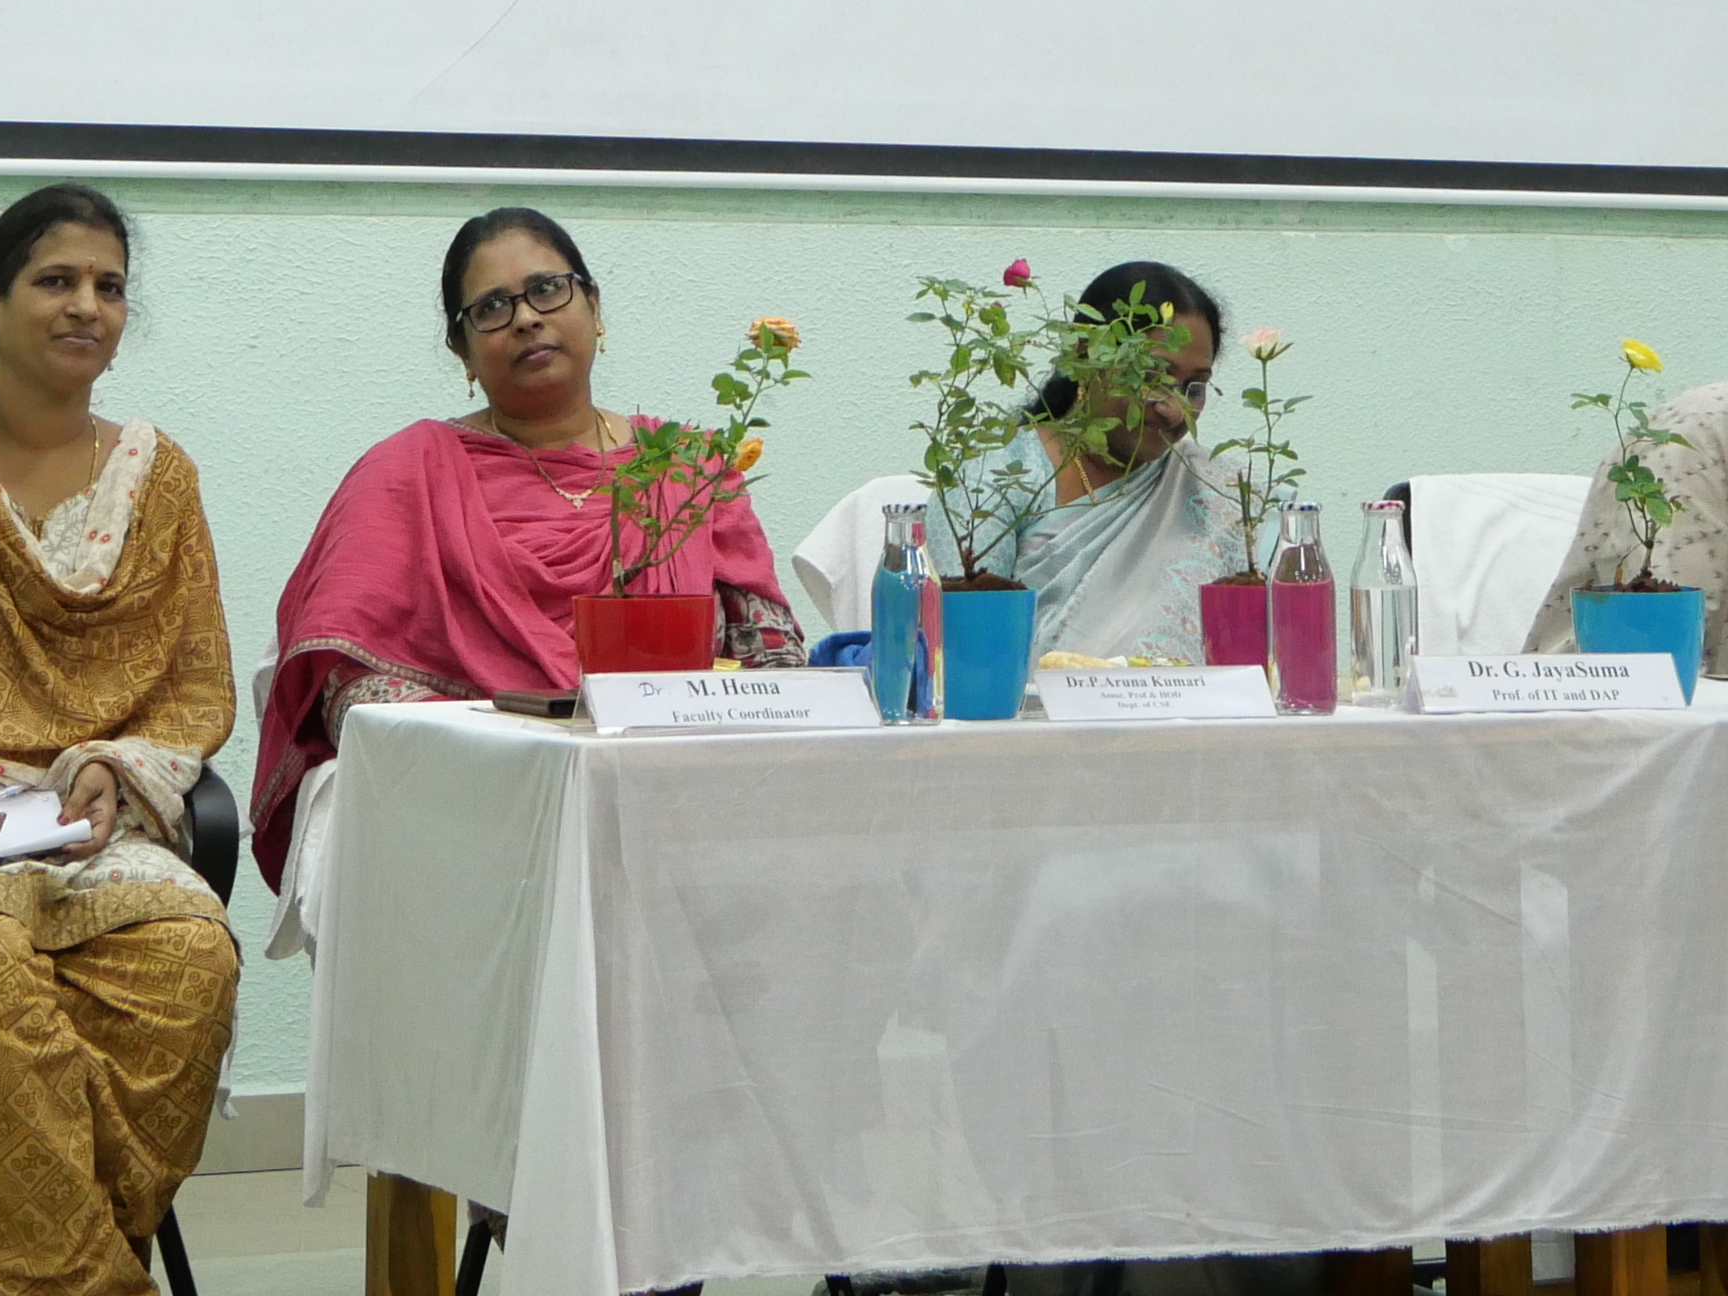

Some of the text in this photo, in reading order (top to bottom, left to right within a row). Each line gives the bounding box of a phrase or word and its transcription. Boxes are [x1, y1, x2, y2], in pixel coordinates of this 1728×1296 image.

[1468, 661, 1630, 682] Dr. G. JayaSuma
[685, 679, 717, 698] M.
[721, 678, 781, 696] Hema
[1152, 674, 1206, 688] Kumari
[1528, 689, 1542, 701] of
[1543, 689, 1558, 701] IT
[1563, 689, 1587, 701] and
[1591, 689, 1620, 701] DAP
[672, 708, 811, 724] Faculty Coordinator
